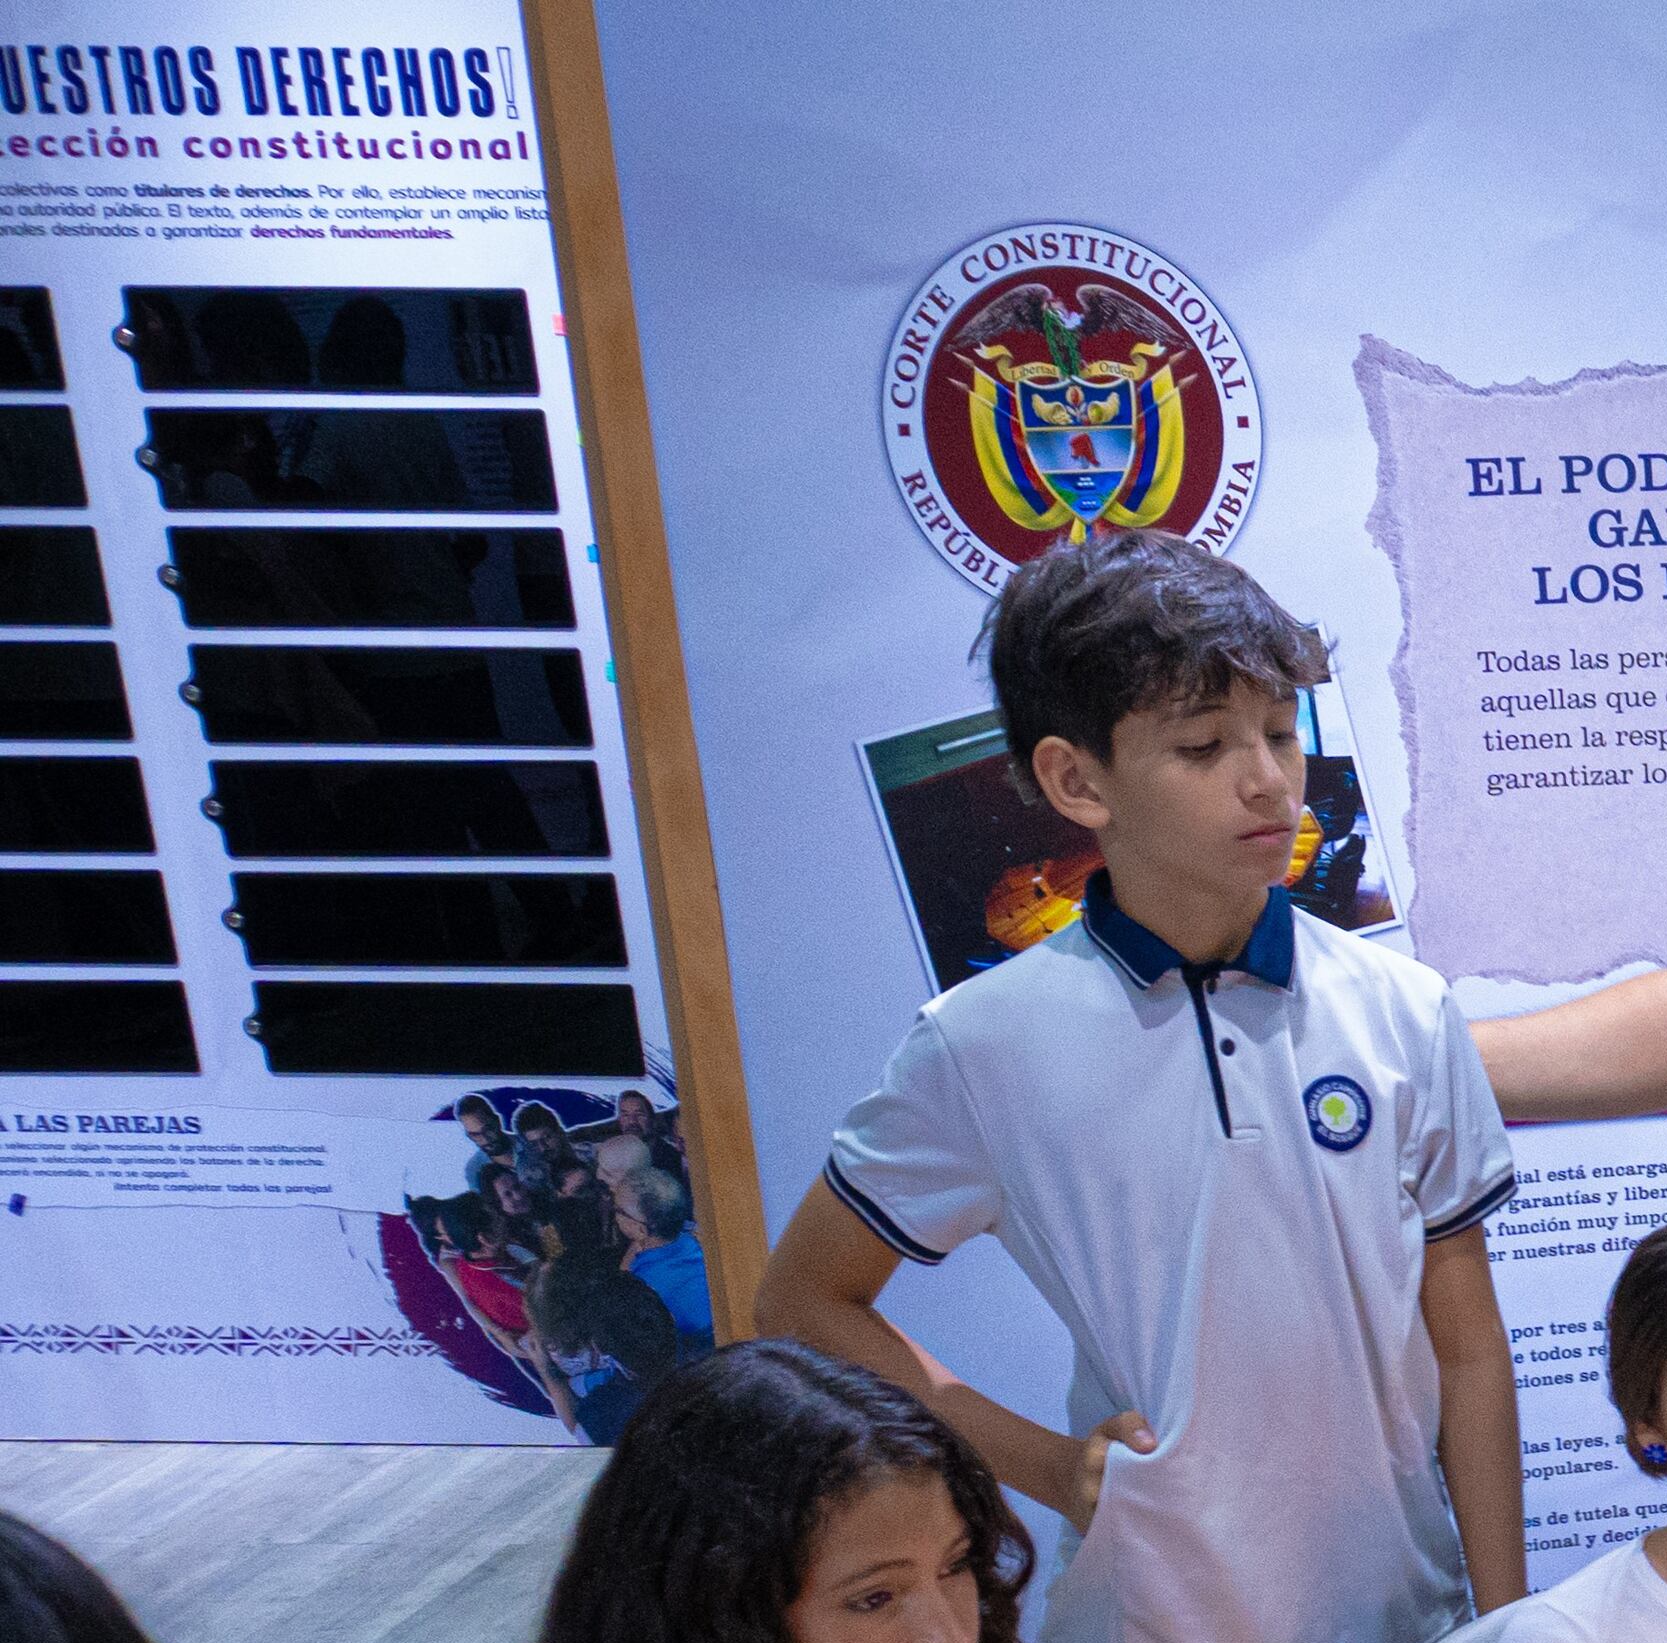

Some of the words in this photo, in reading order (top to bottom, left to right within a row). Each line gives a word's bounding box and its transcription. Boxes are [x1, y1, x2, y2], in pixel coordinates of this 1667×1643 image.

[237, 47, 517, 118] DERECHOS!
[0, 127, 158, 158] ección
[183, 131, 528, 160] constitucional
[85, 186, 128, 197] como
[134, 184, 205, 197] titulares
[209, 184, 230, 198] de
[234, 185, 312, 198] derechos.
[319, 184, 344, 199] Por
[352, 186, 381, 199] ello,
[389, 186, 466, 200] establece
[891, 284, 955, 408] CORTE
[961, 233, 1248, 400] CONSTITUCIONAL
[1099, 362, 1134, 378] Orden
[1466, 457, 1542, 496] EL
[1532, 563, 1643, 604] LOS
[1476, 650, 1561, 673] Todas
[1570, 649, 1609, 670] las
[1487, 766, 1633, 796] garantizar
[15, 1115, 69, 1133] LAS
[77, 1115, 201, 1134] PAREJAS
[1509, 1190, 1601, 1213] garantías
[1497, 1217, 1571, 1236] función
[1578, 1216, 1618, 1230] muy
[1575, 1505, 1629, 1522] tutela
